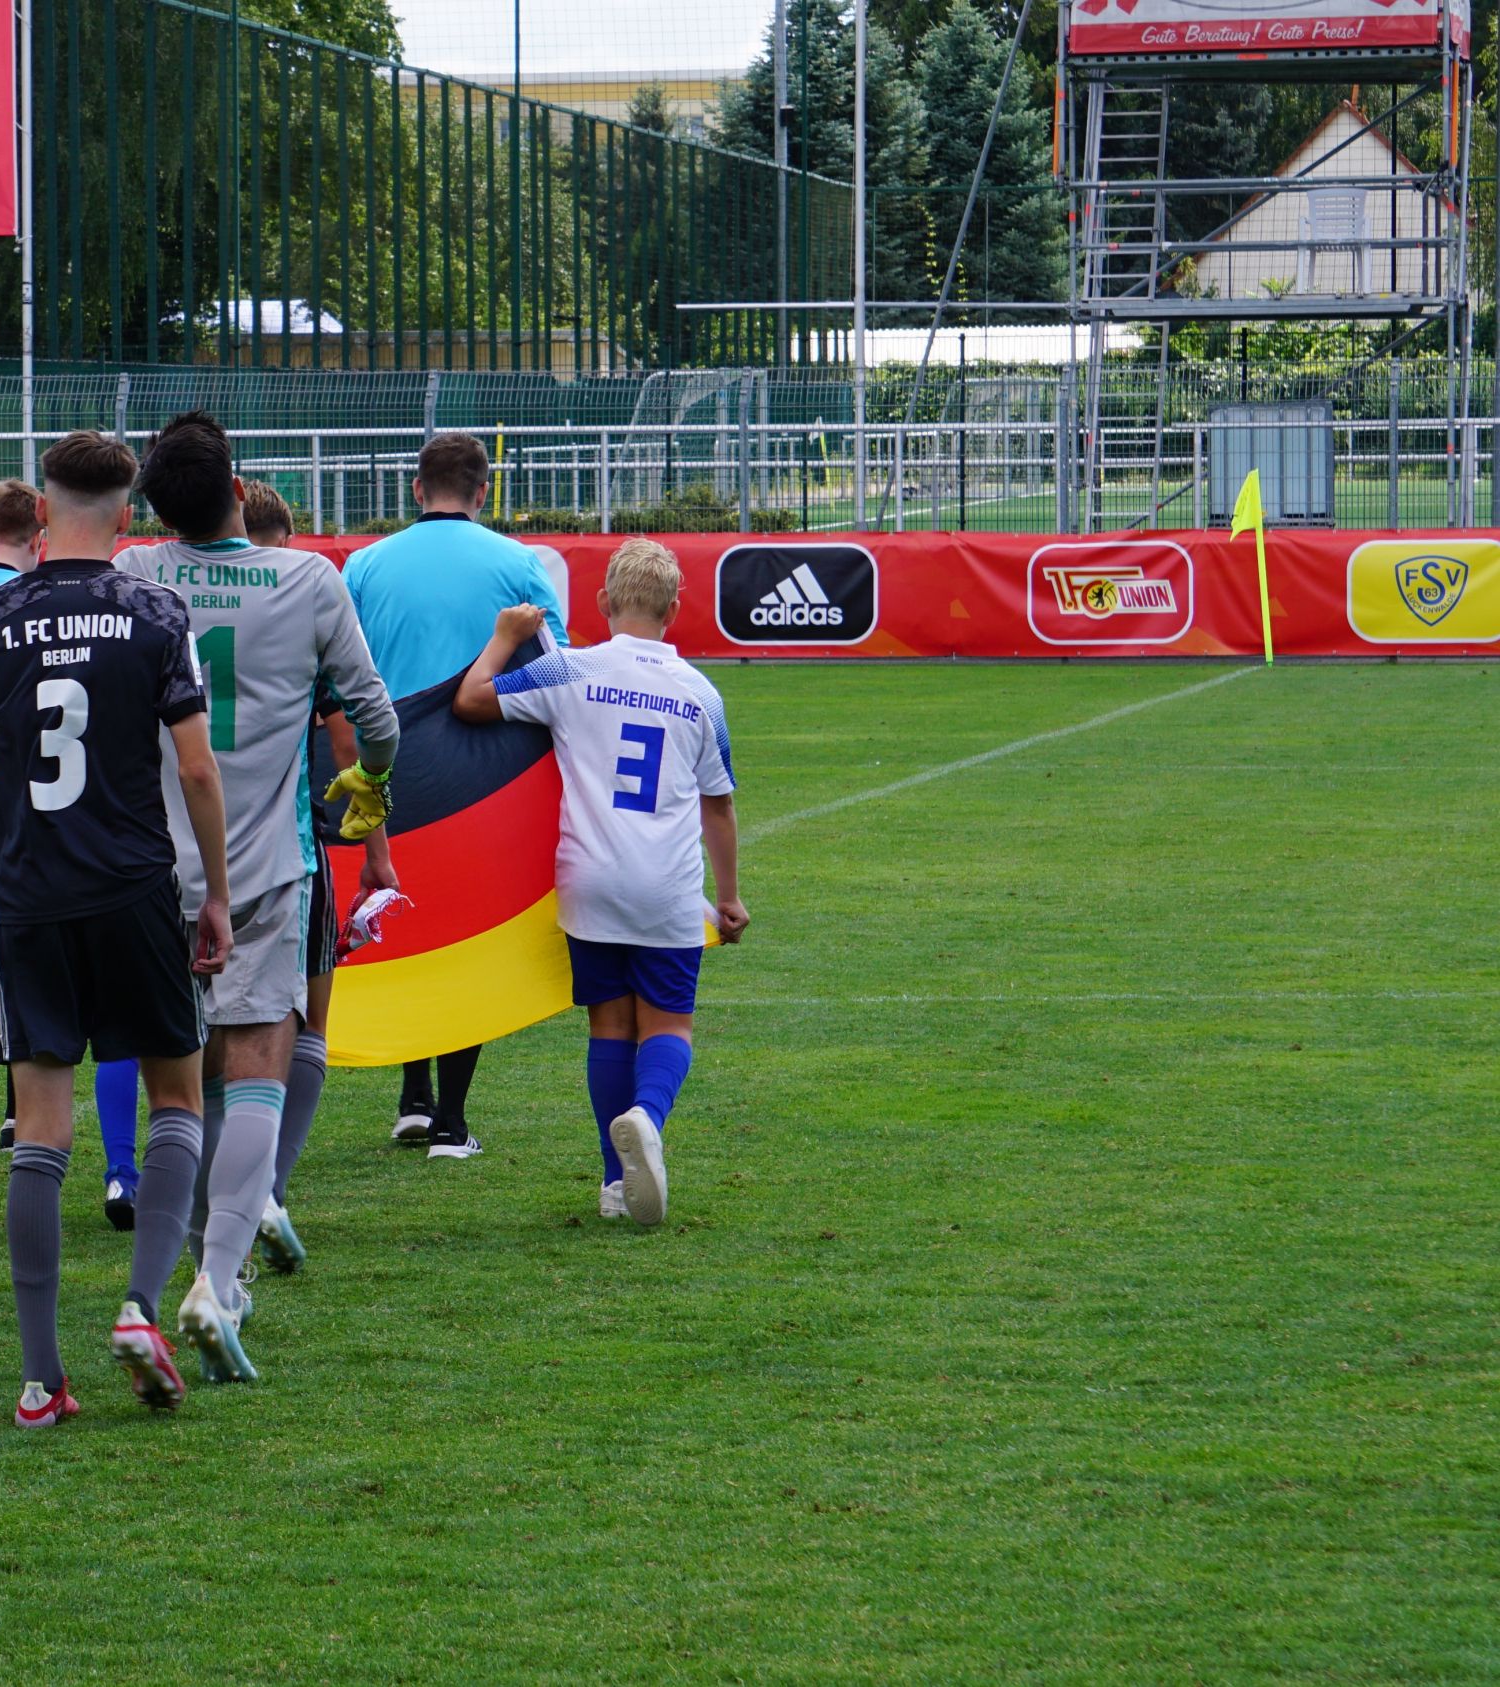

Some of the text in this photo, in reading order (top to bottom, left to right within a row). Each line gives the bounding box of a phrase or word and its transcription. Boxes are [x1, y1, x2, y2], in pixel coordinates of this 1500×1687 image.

[1141, 18, 1365, 47] Gute Beratung! Gute Preise!
[156, 563, 279, 589] 1. FC UNION
[191, 594, 241, 609] BERLIN
[1118, 585, 1171, 608] UNION
[1424, 587, 1439, 598] 63
[749, 602, 844, 626] adidas
[1, 613, 133, 650] 1. FC UNION
[42, 646, 91, 667] BERLIN
[196, 625, 236, 752] 1
[586, 684, 701, 723] LUCKENWALDE
[29, 678, 89, 812] 3
[612, 722, 666, 814] 3
